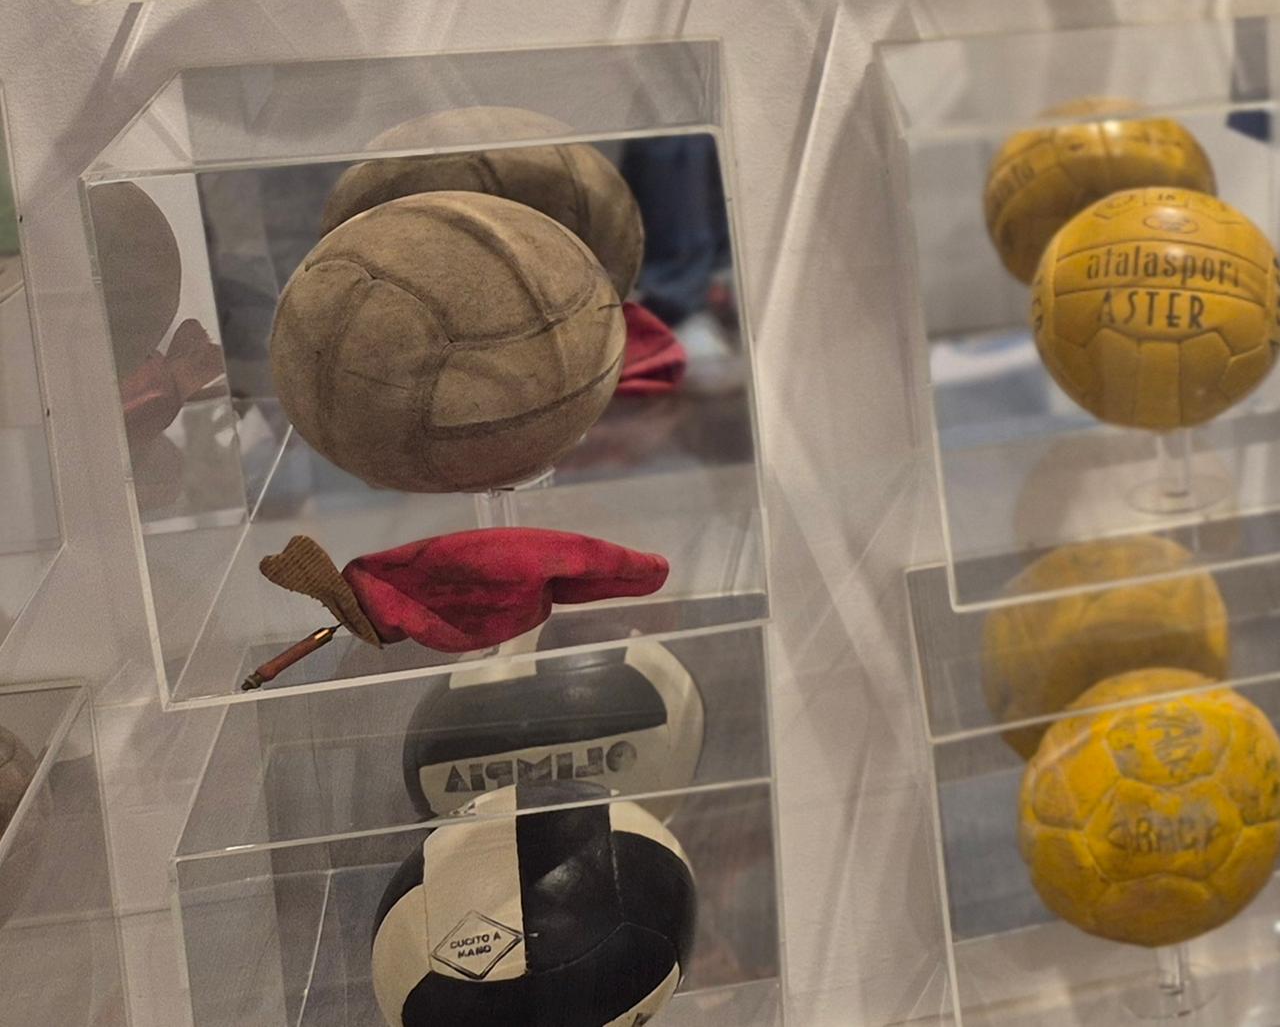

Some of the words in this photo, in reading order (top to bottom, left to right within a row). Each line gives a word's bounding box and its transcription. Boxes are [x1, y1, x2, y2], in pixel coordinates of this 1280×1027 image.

[1098, 289, 1206, 330] ASTER
[449, 933, 490, 950] CUCITO
[493, 931, 502, 942] A
[457, 944, 492, 959] MANO
